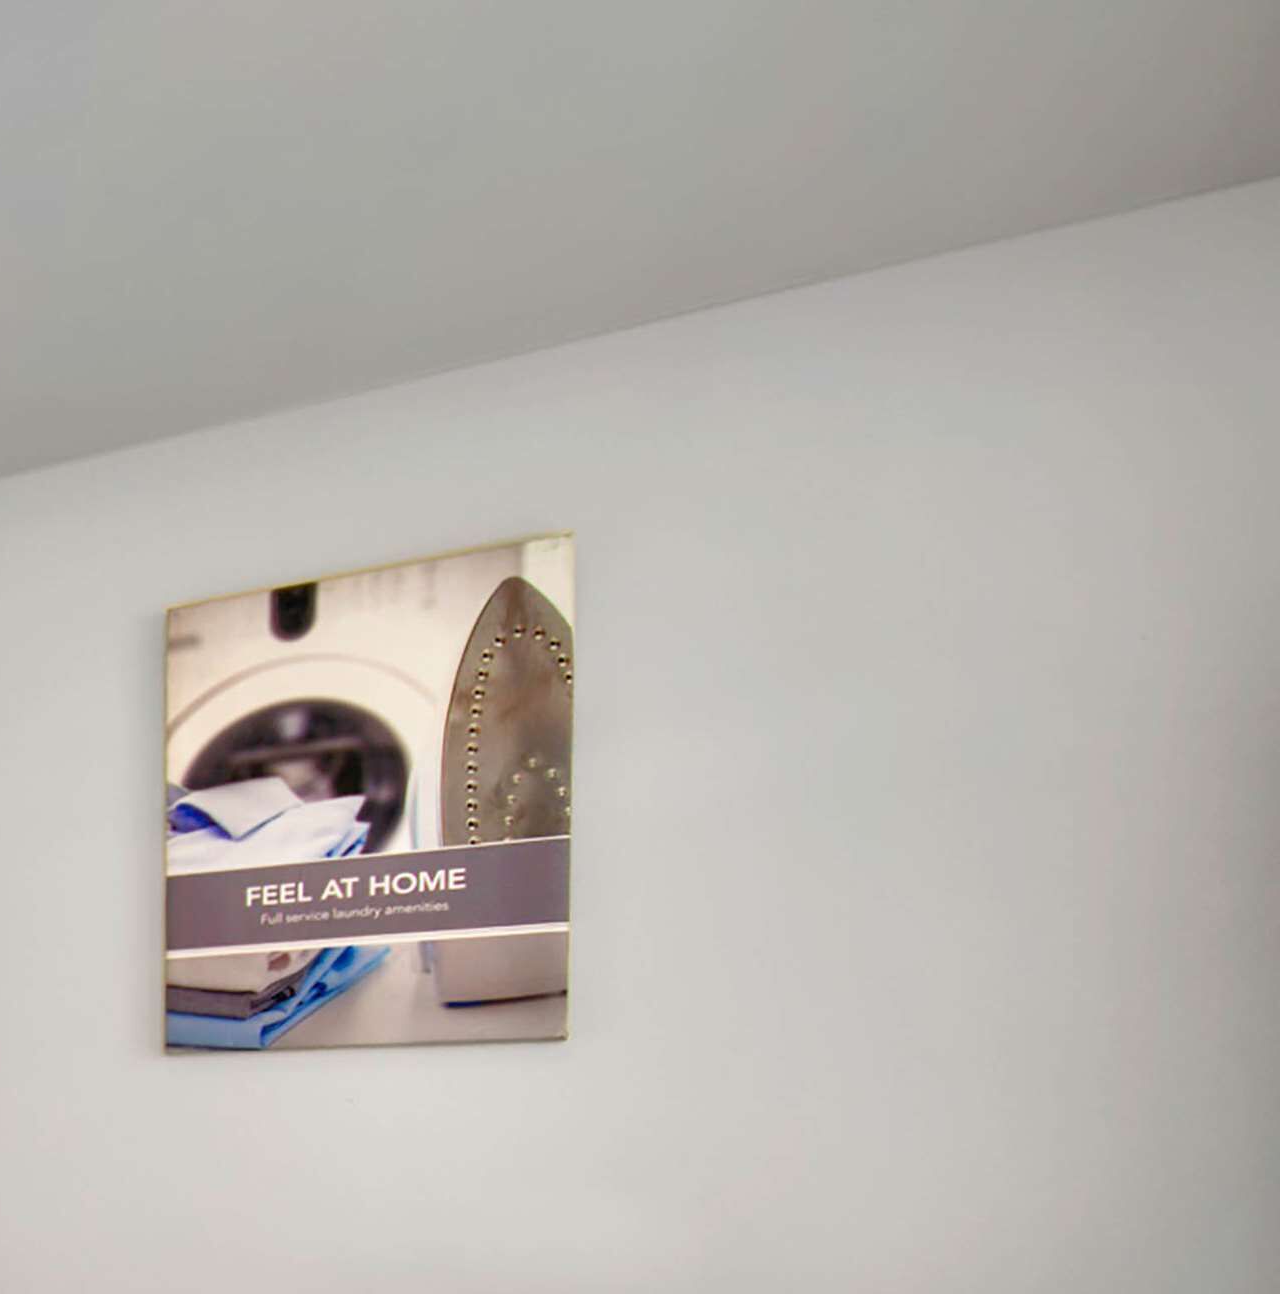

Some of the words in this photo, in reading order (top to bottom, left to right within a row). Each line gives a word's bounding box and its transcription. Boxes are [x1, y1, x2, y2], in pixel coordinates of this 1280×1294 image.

[245, 882, 312, 907] FEEL
[321, 877, 359, 900] AT
[369, 868, 467, 896] HOME
[260, 912, 284, 925] Full
[285, 911, 329, 924] service
[333, 906, 381, 920] laundry
[385, 901, 449, 915] amenities
